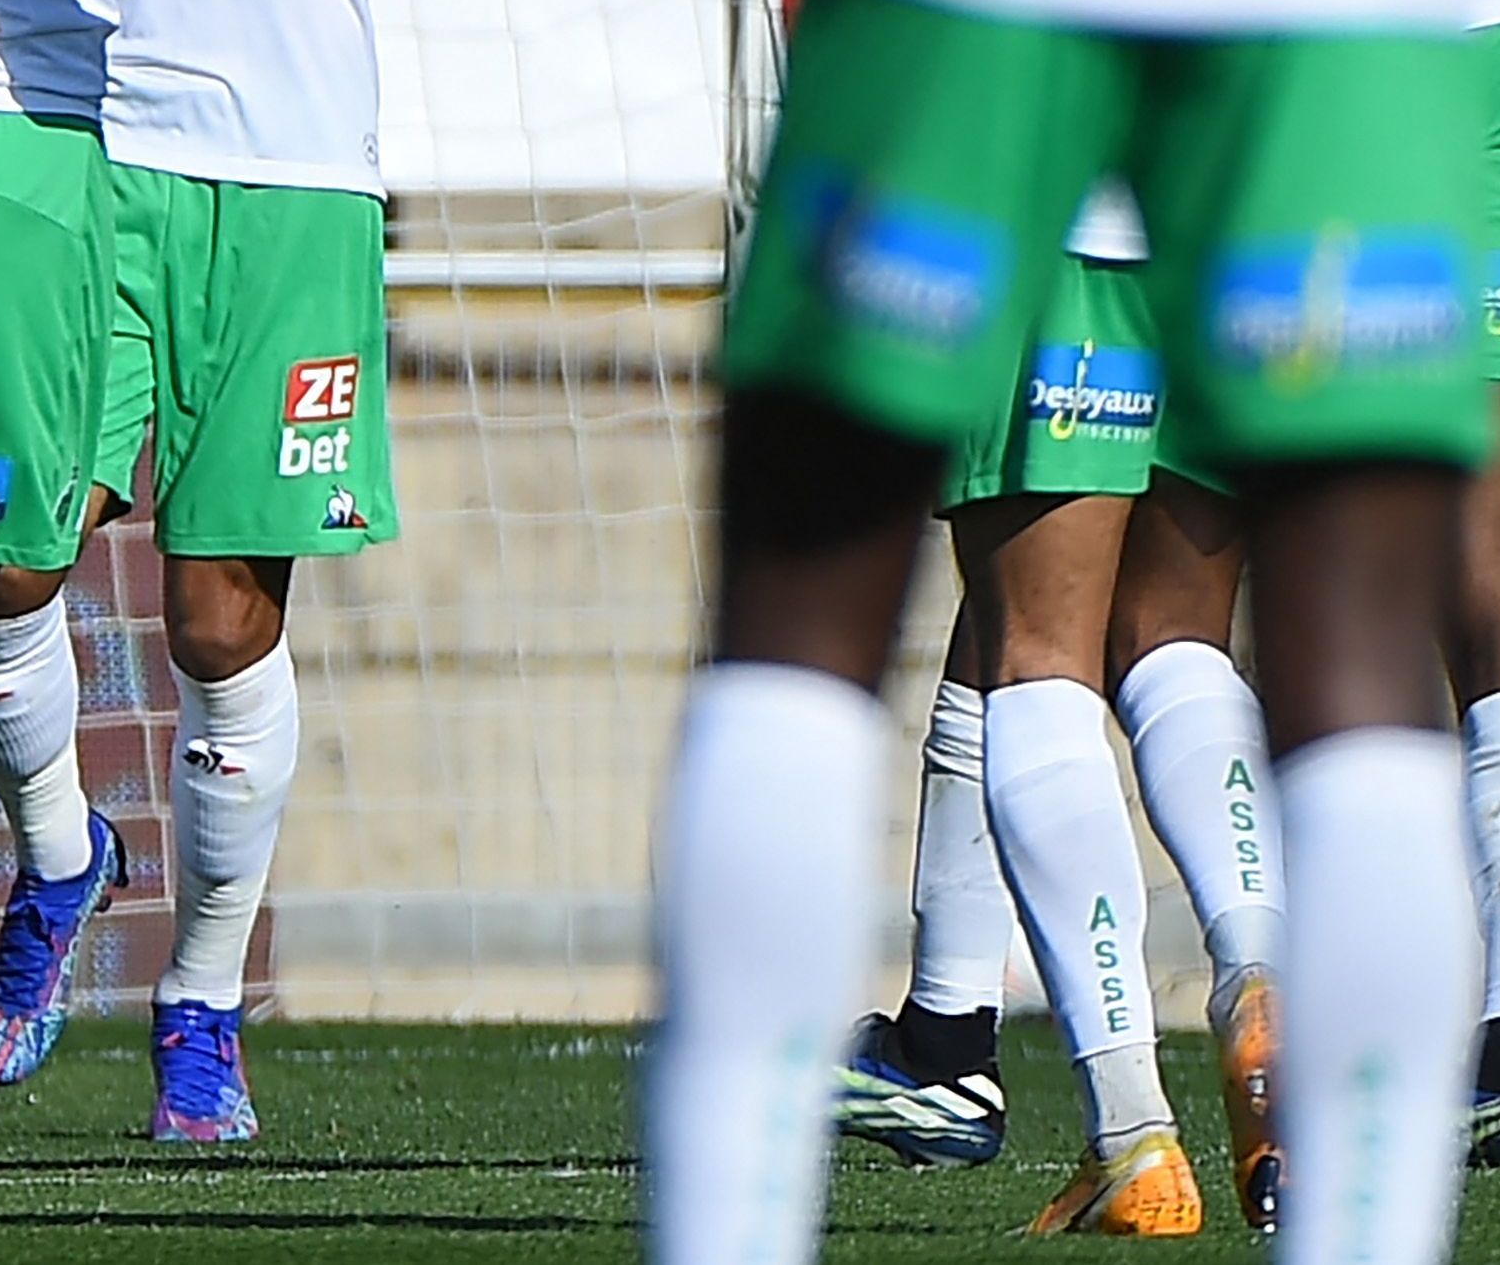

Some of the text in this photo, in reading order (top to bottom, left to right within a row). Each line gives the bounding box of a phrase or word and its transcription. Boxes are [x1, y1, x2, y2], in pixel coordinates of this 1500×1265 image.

[294, 364, 356, 418] ZE
[278, 426, 351, 477] bet
[1224, 758, 1264, 893] ASSE
[1089, 895, 1130, 1034] ASSE
